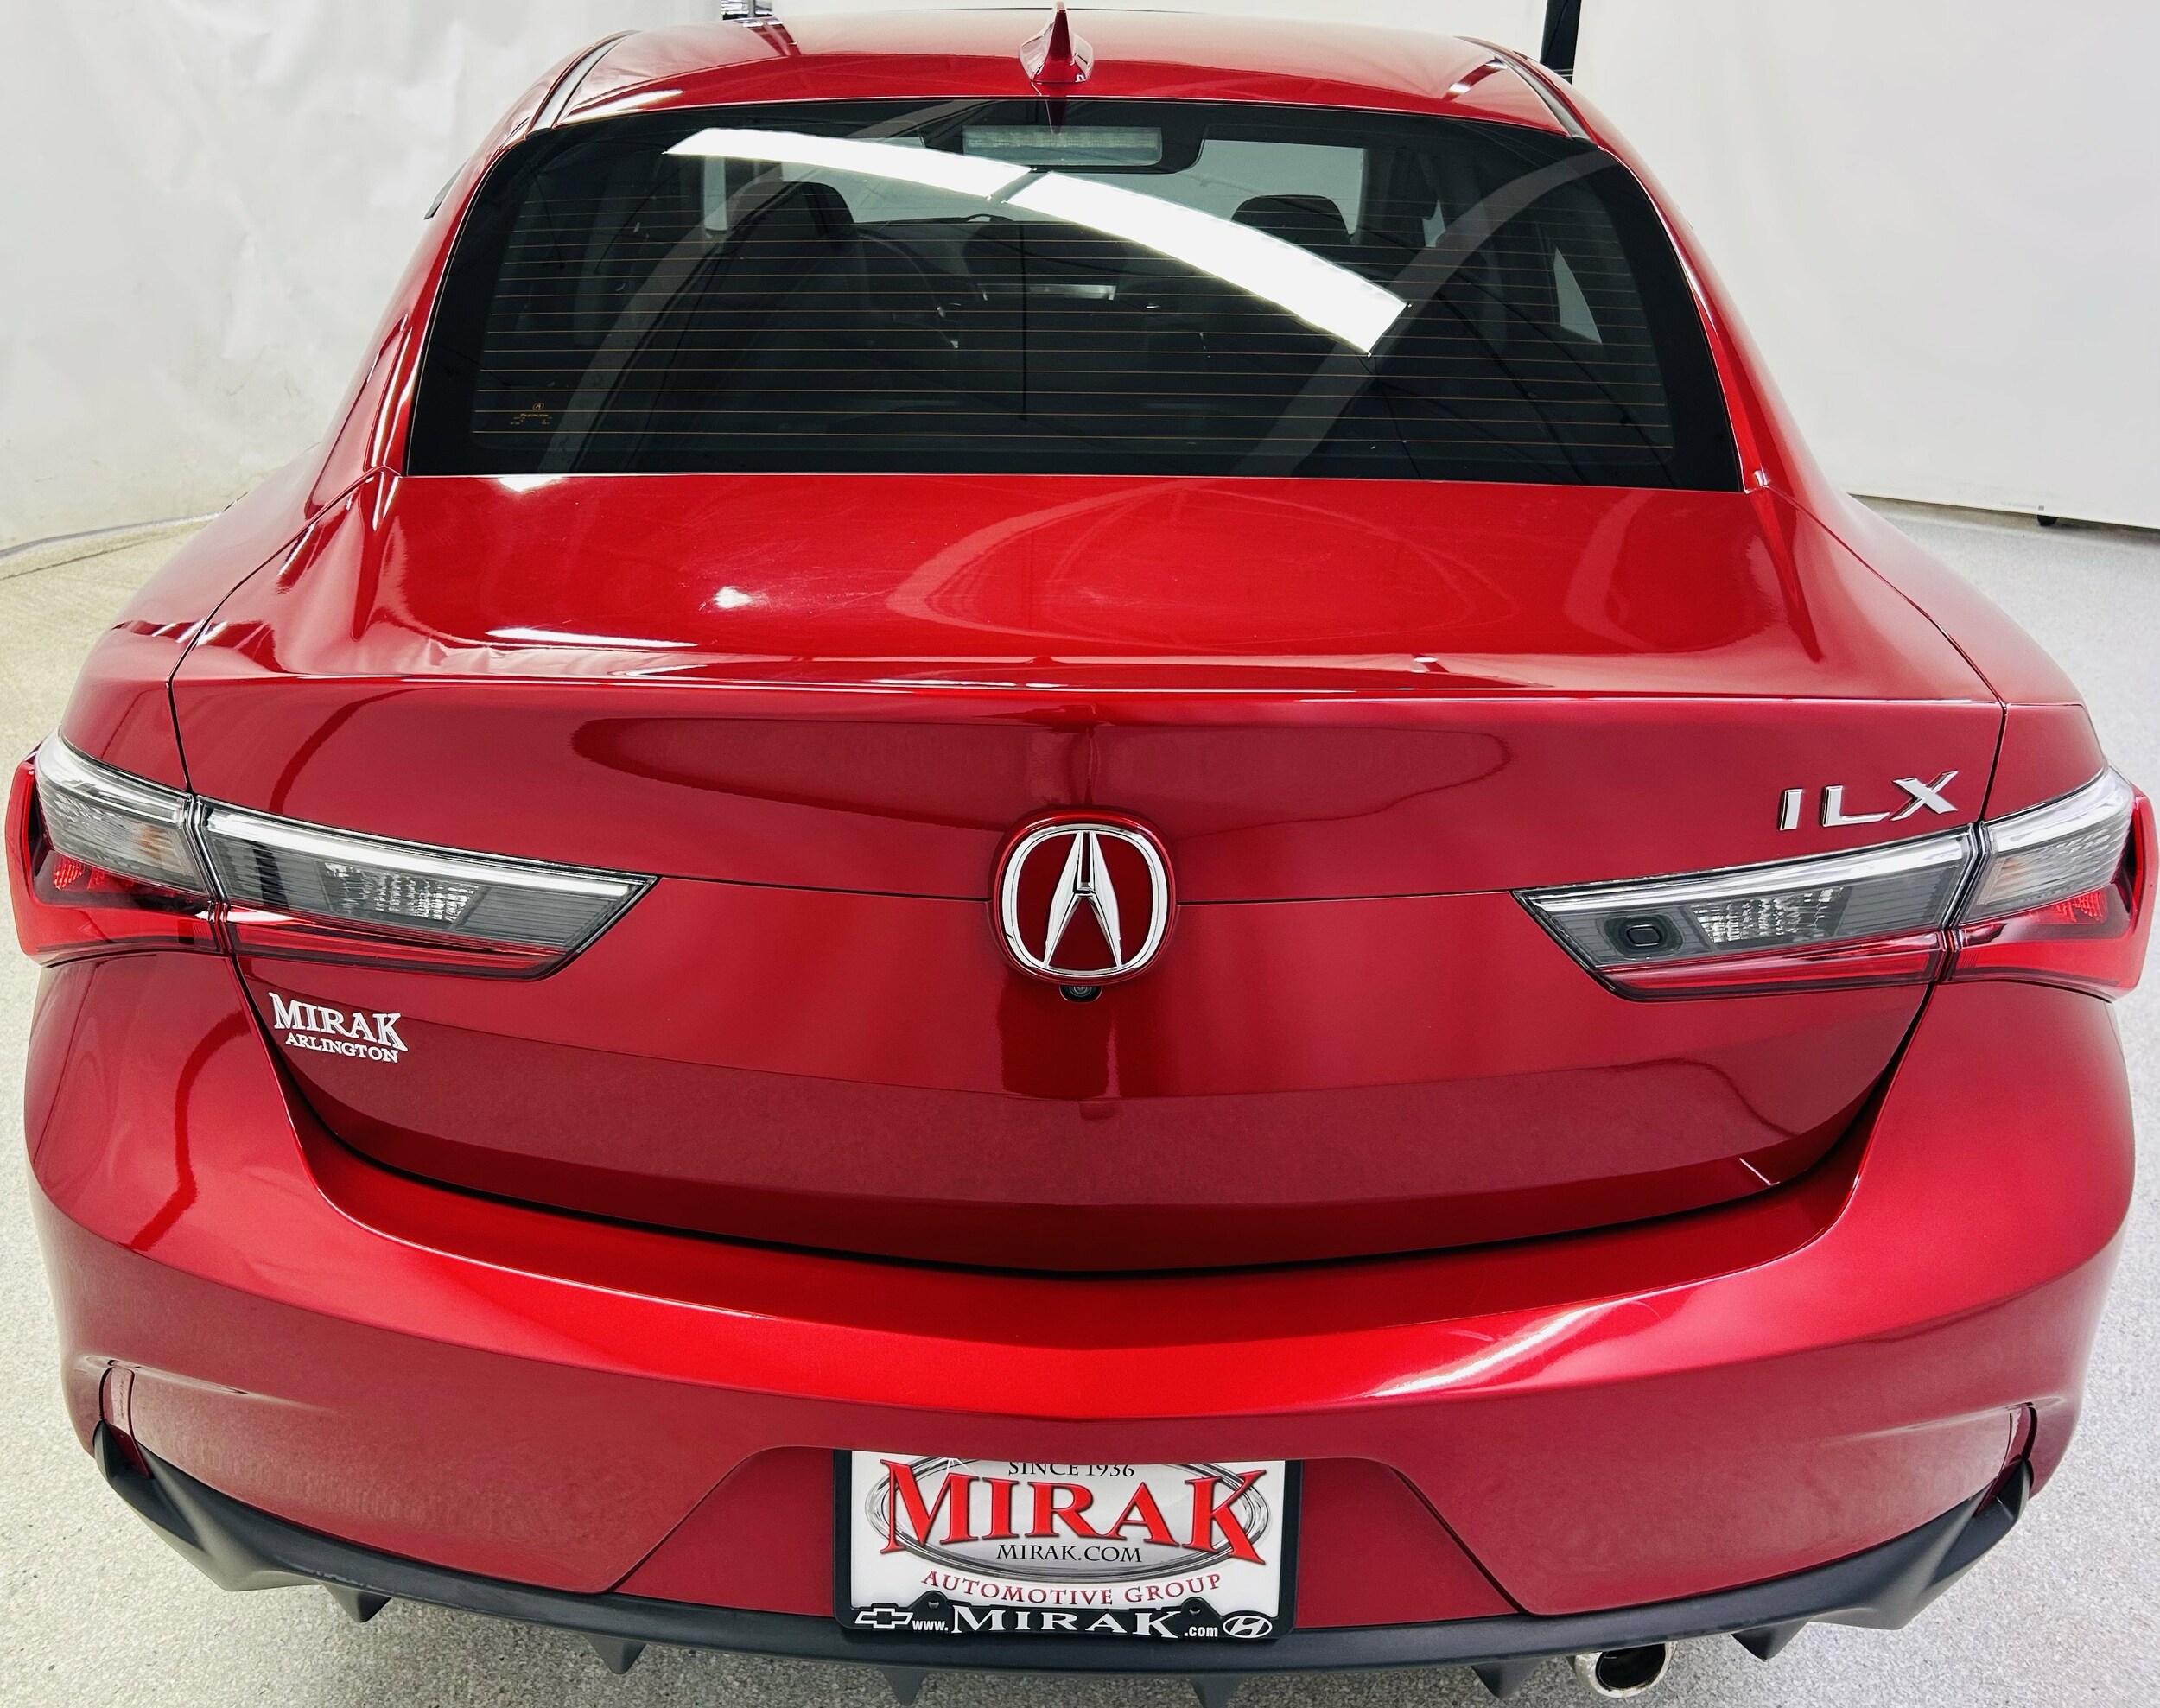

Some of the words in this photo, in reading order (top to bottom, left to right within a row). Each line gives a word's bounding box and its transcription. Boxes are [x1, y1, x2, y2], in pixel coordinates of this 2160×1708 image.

[1779, 770, 1959, 831] ILX
[268, 992, 409, 1051] MIRAK
[285, 1032, 398, 1064] ARLINGTON
[1008, 1461, 1079, 1476] SINCE
[1085, 1464, 1135, 1477] 1936
[880, 1459, 1267, 1565] MIRAK
[996, 1544, 1142, 1563] MIRAK.COM
[921, 1570, 1113, 1605] AUTOMOTIVE
[1123, 1573, 1222, 1603] GROUP
